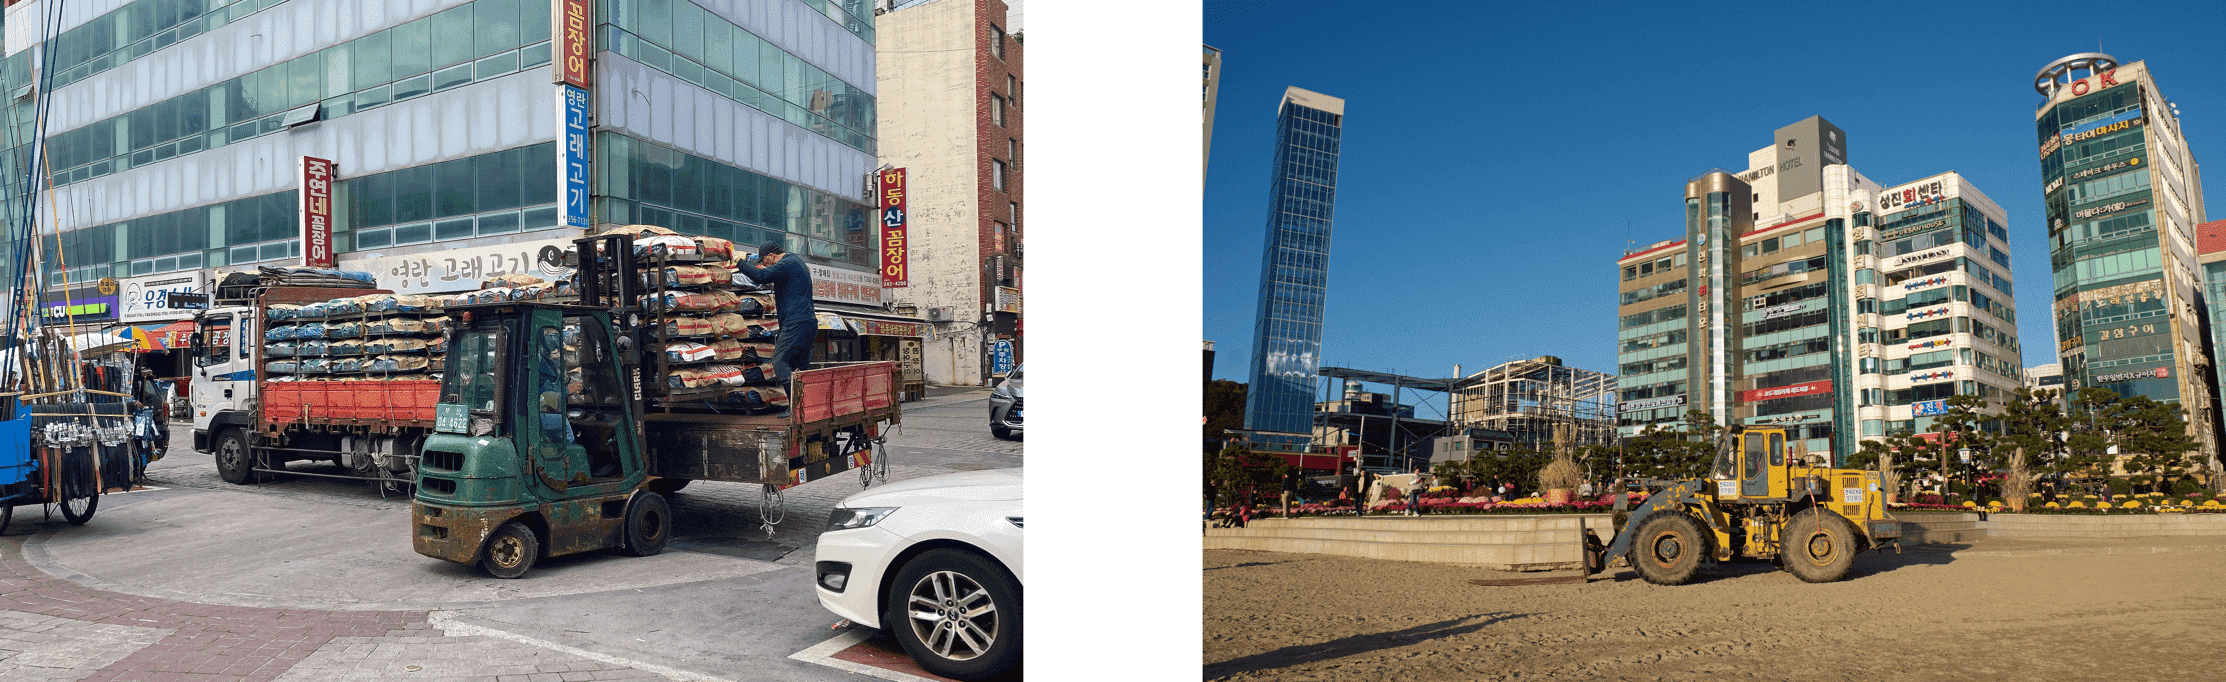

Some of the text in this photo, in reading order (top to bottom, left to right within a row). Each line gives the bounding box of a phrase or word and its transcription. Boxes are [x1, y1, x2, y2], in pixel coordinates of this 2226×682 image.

[567, 89, 586, 108] 영란
[569, 107, 585, 214] 고래고기
[1779, 156, 1803, 172] HOTEL
[2073, 161, 2126, 179] 스테이크 하우스
[1899, 220, 1944, 236] URBAN HOUSE
[391, 251, 529, 289] 영란 고래고기
[54, 305, 66, 318] CU
[632, 367, 642, 401] CLARK
